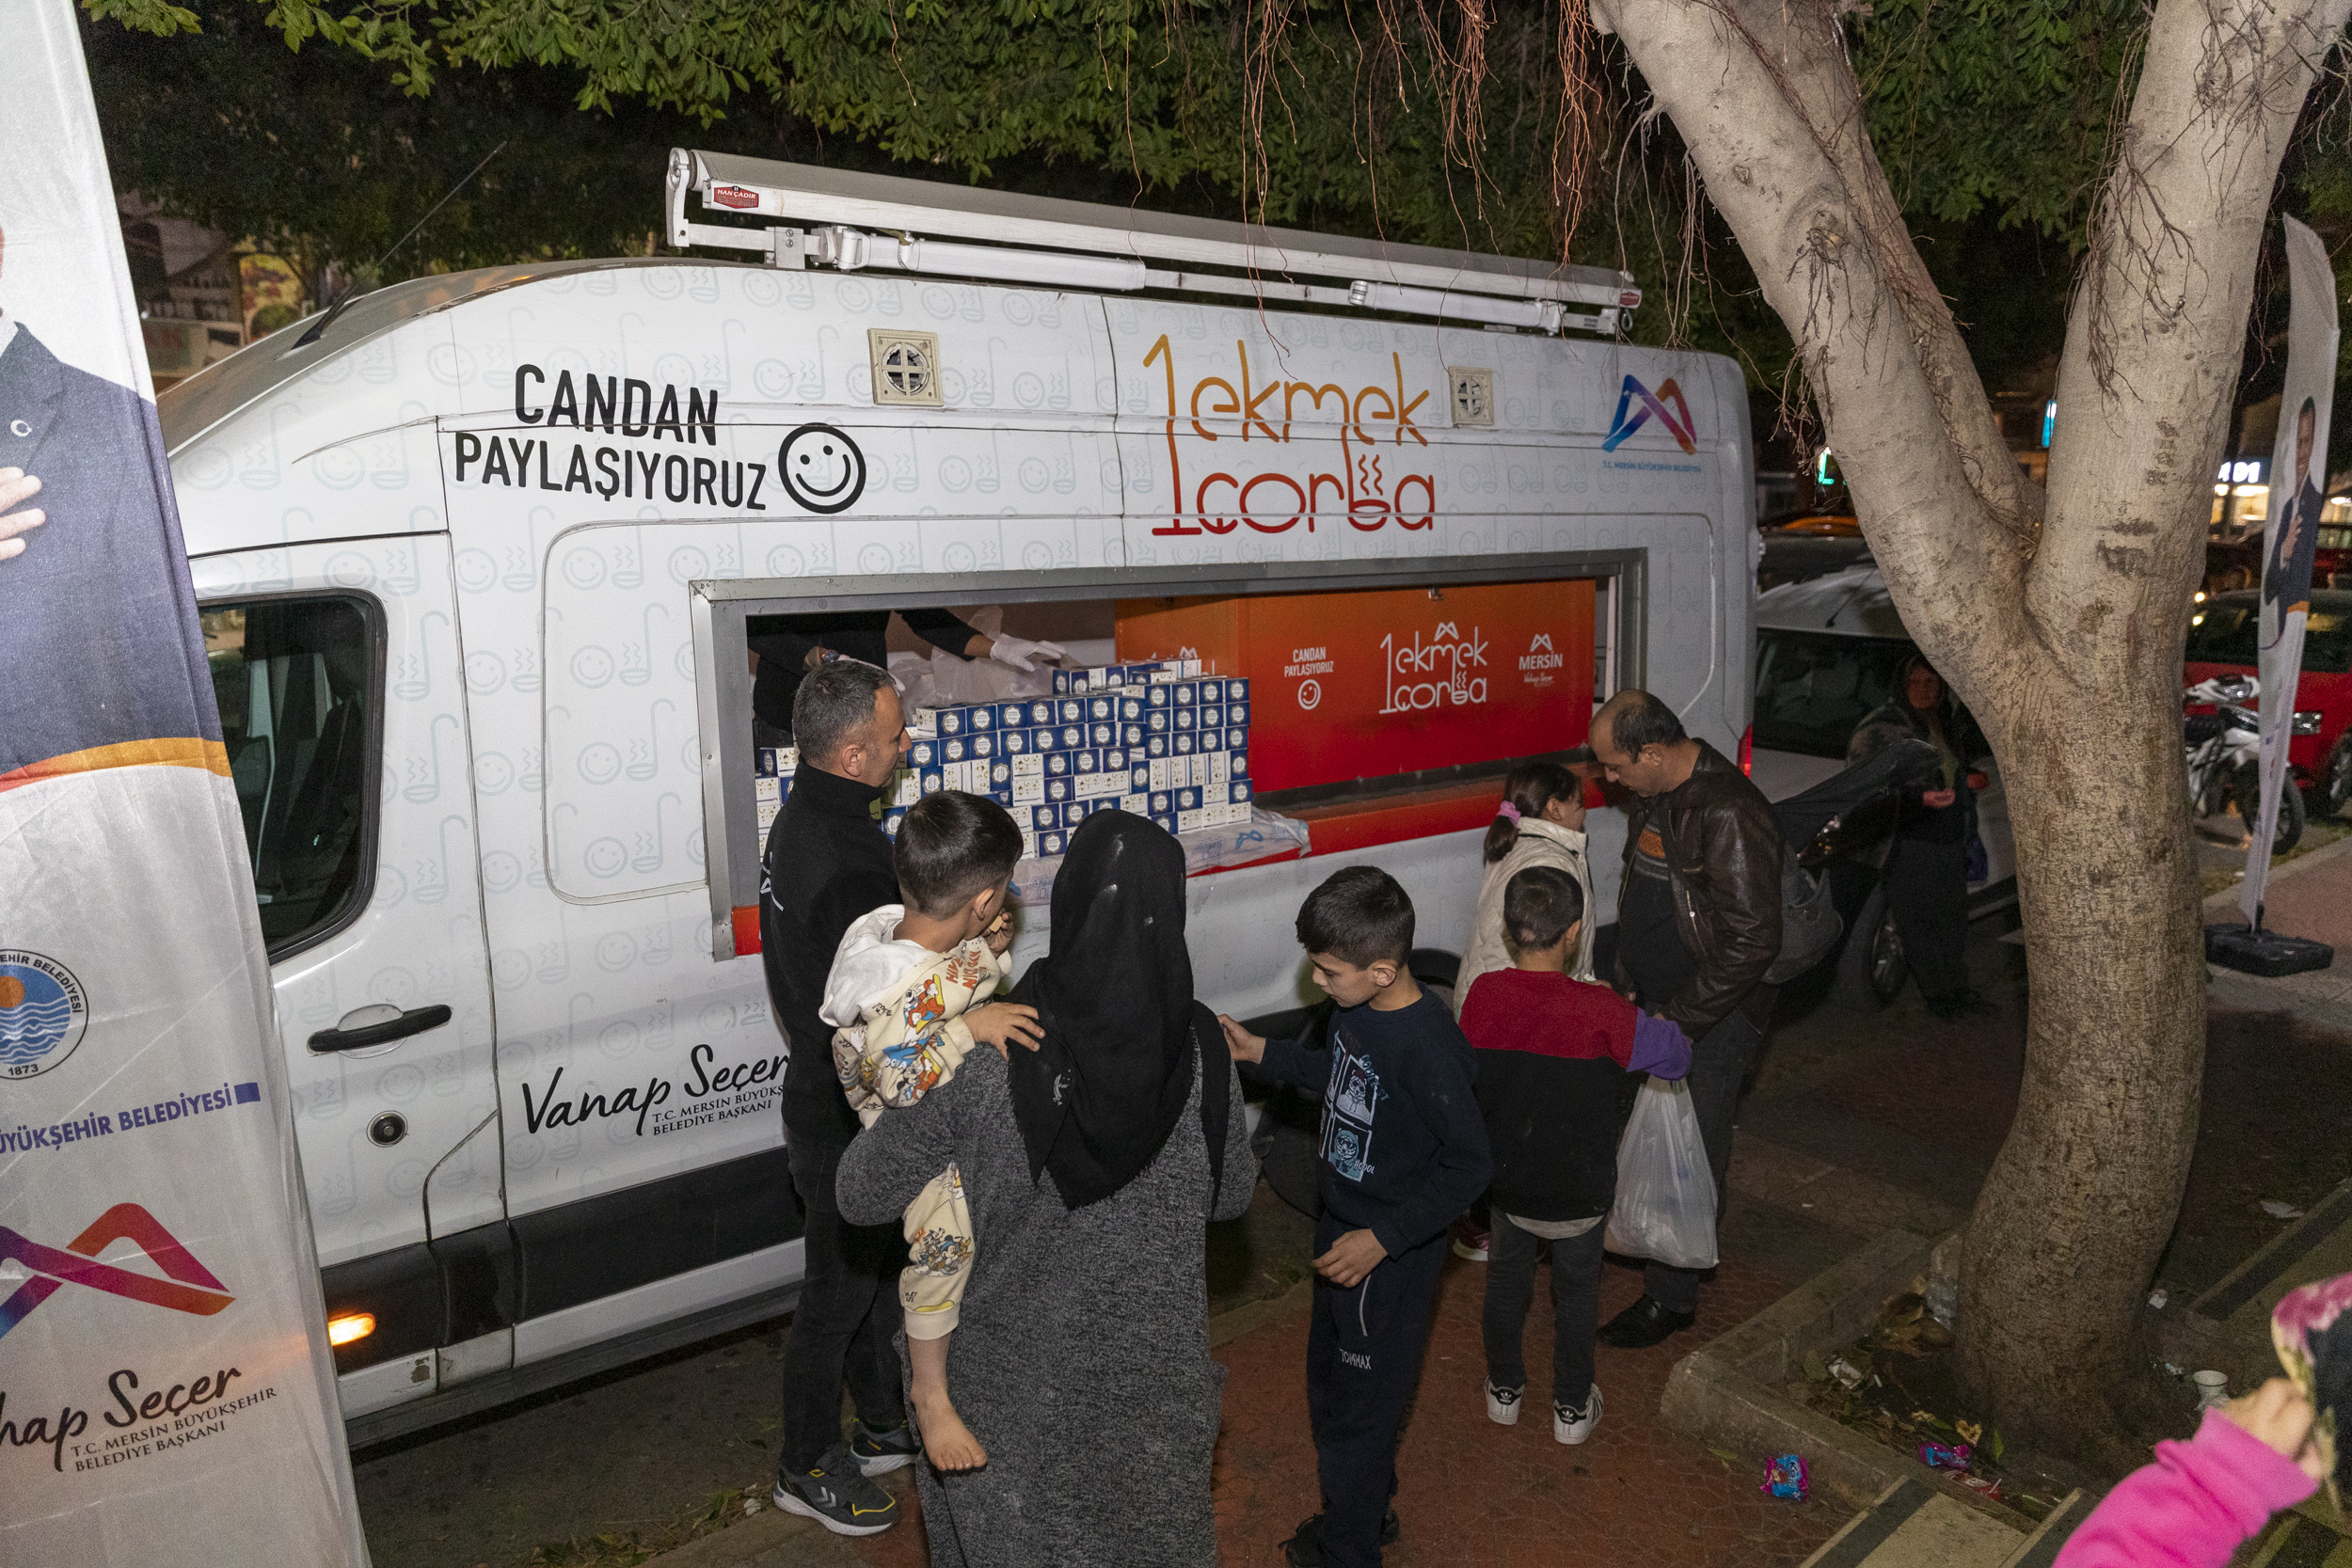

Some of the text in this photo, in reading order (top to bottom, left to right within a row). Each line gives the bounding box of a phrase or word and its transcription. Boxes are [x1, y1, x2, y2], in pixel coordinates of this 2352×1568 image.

[515, 363, 719, 447] CANDAN
[1190, 339, 1430, 447] ekmek
[455, 431, 767, 511] PAYLAŞIYORUZ
[1284, 660, 1334, 677] PAYLAŞIYORUZ
[1293, 646, 1326, 663] CANDAN
[1395, 626, 1488, 673] ekmek
[1518, 650, 1563, 671] MERSİN
[0, 953, 84, 1013] EHİR BELEDİYESİ
[8, 1064, 39, 1076] 1873
[684, 1044, 788, 1098] Seçer
[119, 1082, 232, 1131] BELEDİYESİ
[652, 1085, 783, 1123] T.C. MERSİN BÜYÜKŞ
[653, 1100, 771, 1135] BELEDİYE BAŞKANI
[71, 1387, 277, 1457] T.C. MERSİN BÜYÜKŞEHİR
[103, 1368, 242, 1428] Seçer
[75, 1420, 225, 1472] BELEDİYE BAŞKANI
